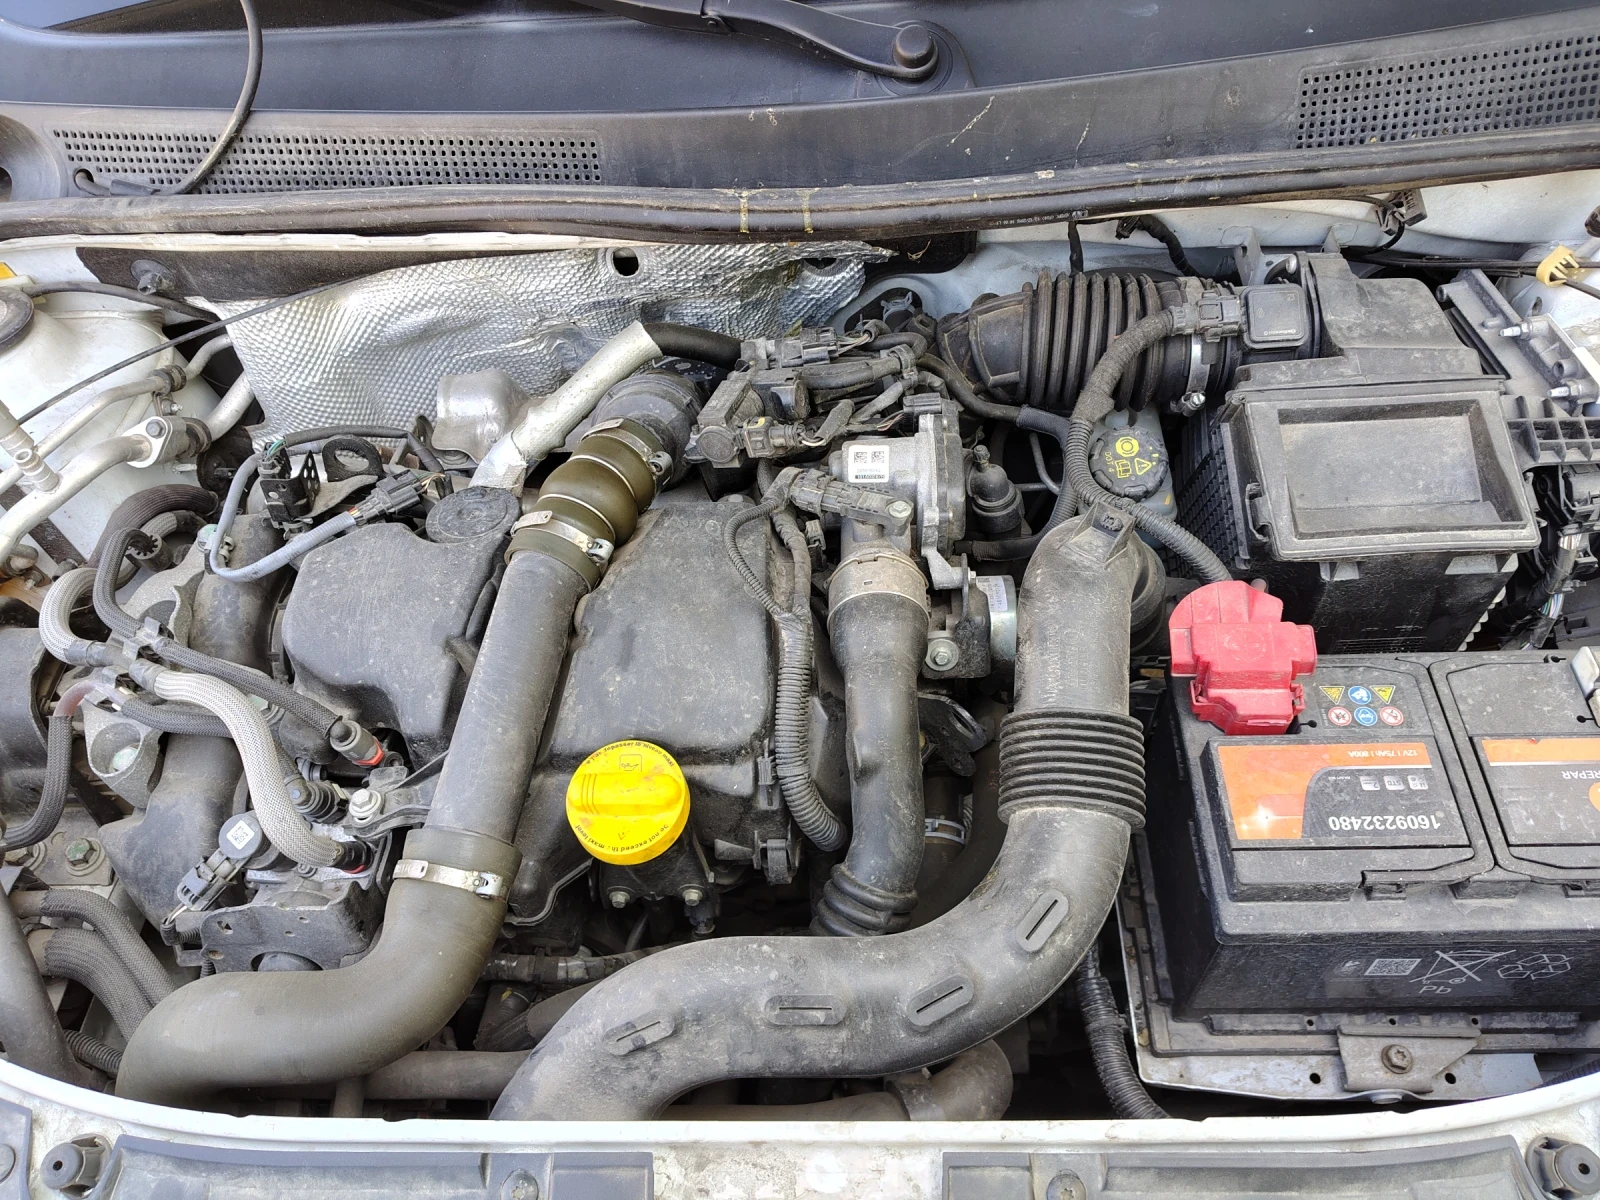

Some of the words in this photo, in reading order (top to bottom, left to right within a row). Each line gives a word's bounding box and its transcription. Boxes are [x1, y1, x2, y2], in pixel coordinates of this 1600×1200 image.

[1104, 451, 1114, 465] DOT
[1347, 750, 1370, 758] 800A
[1375, 749, 1396, 757] 75Ah
[1403, 749, 1418, 757] 12V
[1328, 814, 1441, 831] 1609232480
[574, 824, 589, 840] level
[647, 831, 660, 842] not
[587, 837, 606, 849] maxi
[620, 840, 648, 853] exceed
[1418, 984, 1453, 995] Pb
